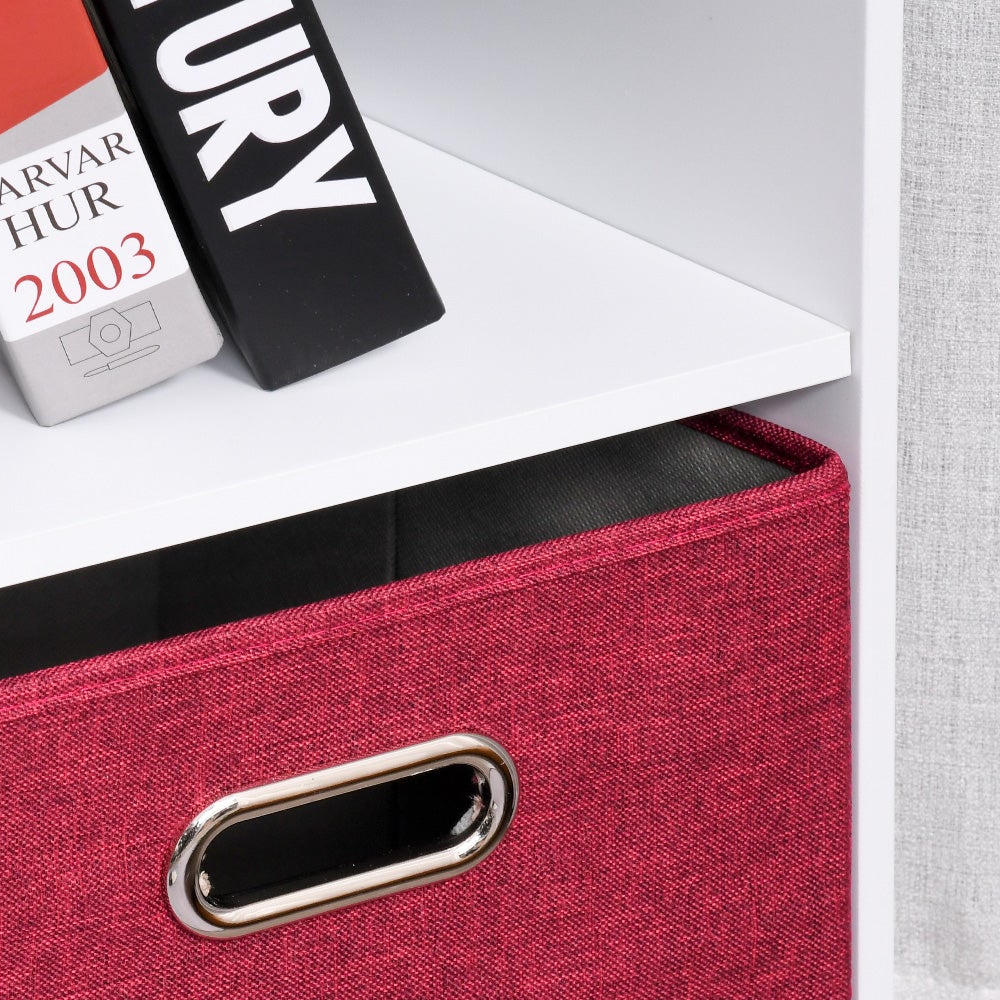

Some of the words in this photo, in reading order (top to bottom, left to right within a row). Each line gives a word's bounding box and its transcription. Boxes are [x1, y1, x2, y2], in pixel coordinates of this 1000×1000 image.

[130, 0, 377, 232] URY
[0, 181, 123, 250] HUR
[14, 231, 156, 323] 2003
